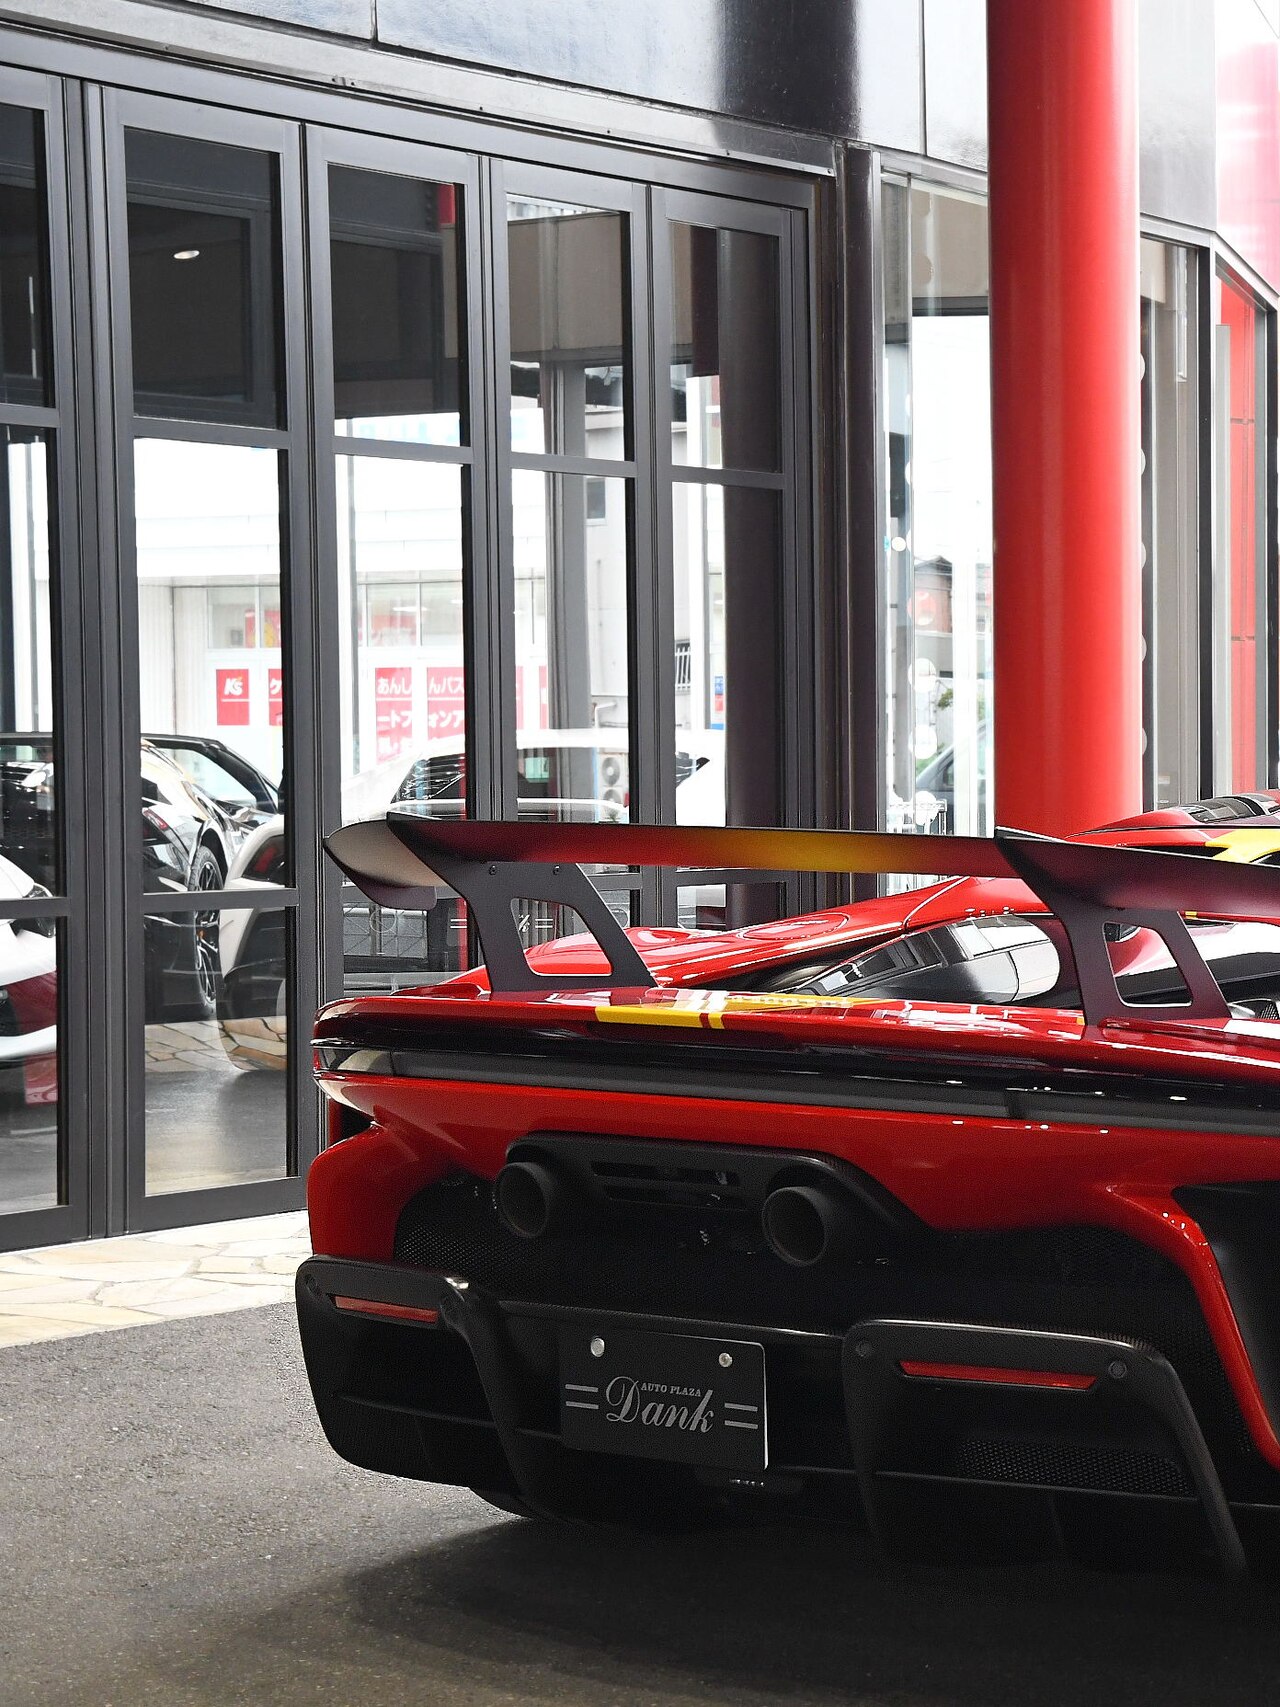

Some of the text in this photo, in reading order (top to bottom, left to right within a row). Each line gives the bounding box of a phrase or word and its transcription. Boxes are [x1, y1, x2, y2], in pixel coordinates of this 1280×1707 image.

[605, 1375, 714, 1434] Dank
[641, 1382, 701, 1398] AUTO PLAZA
